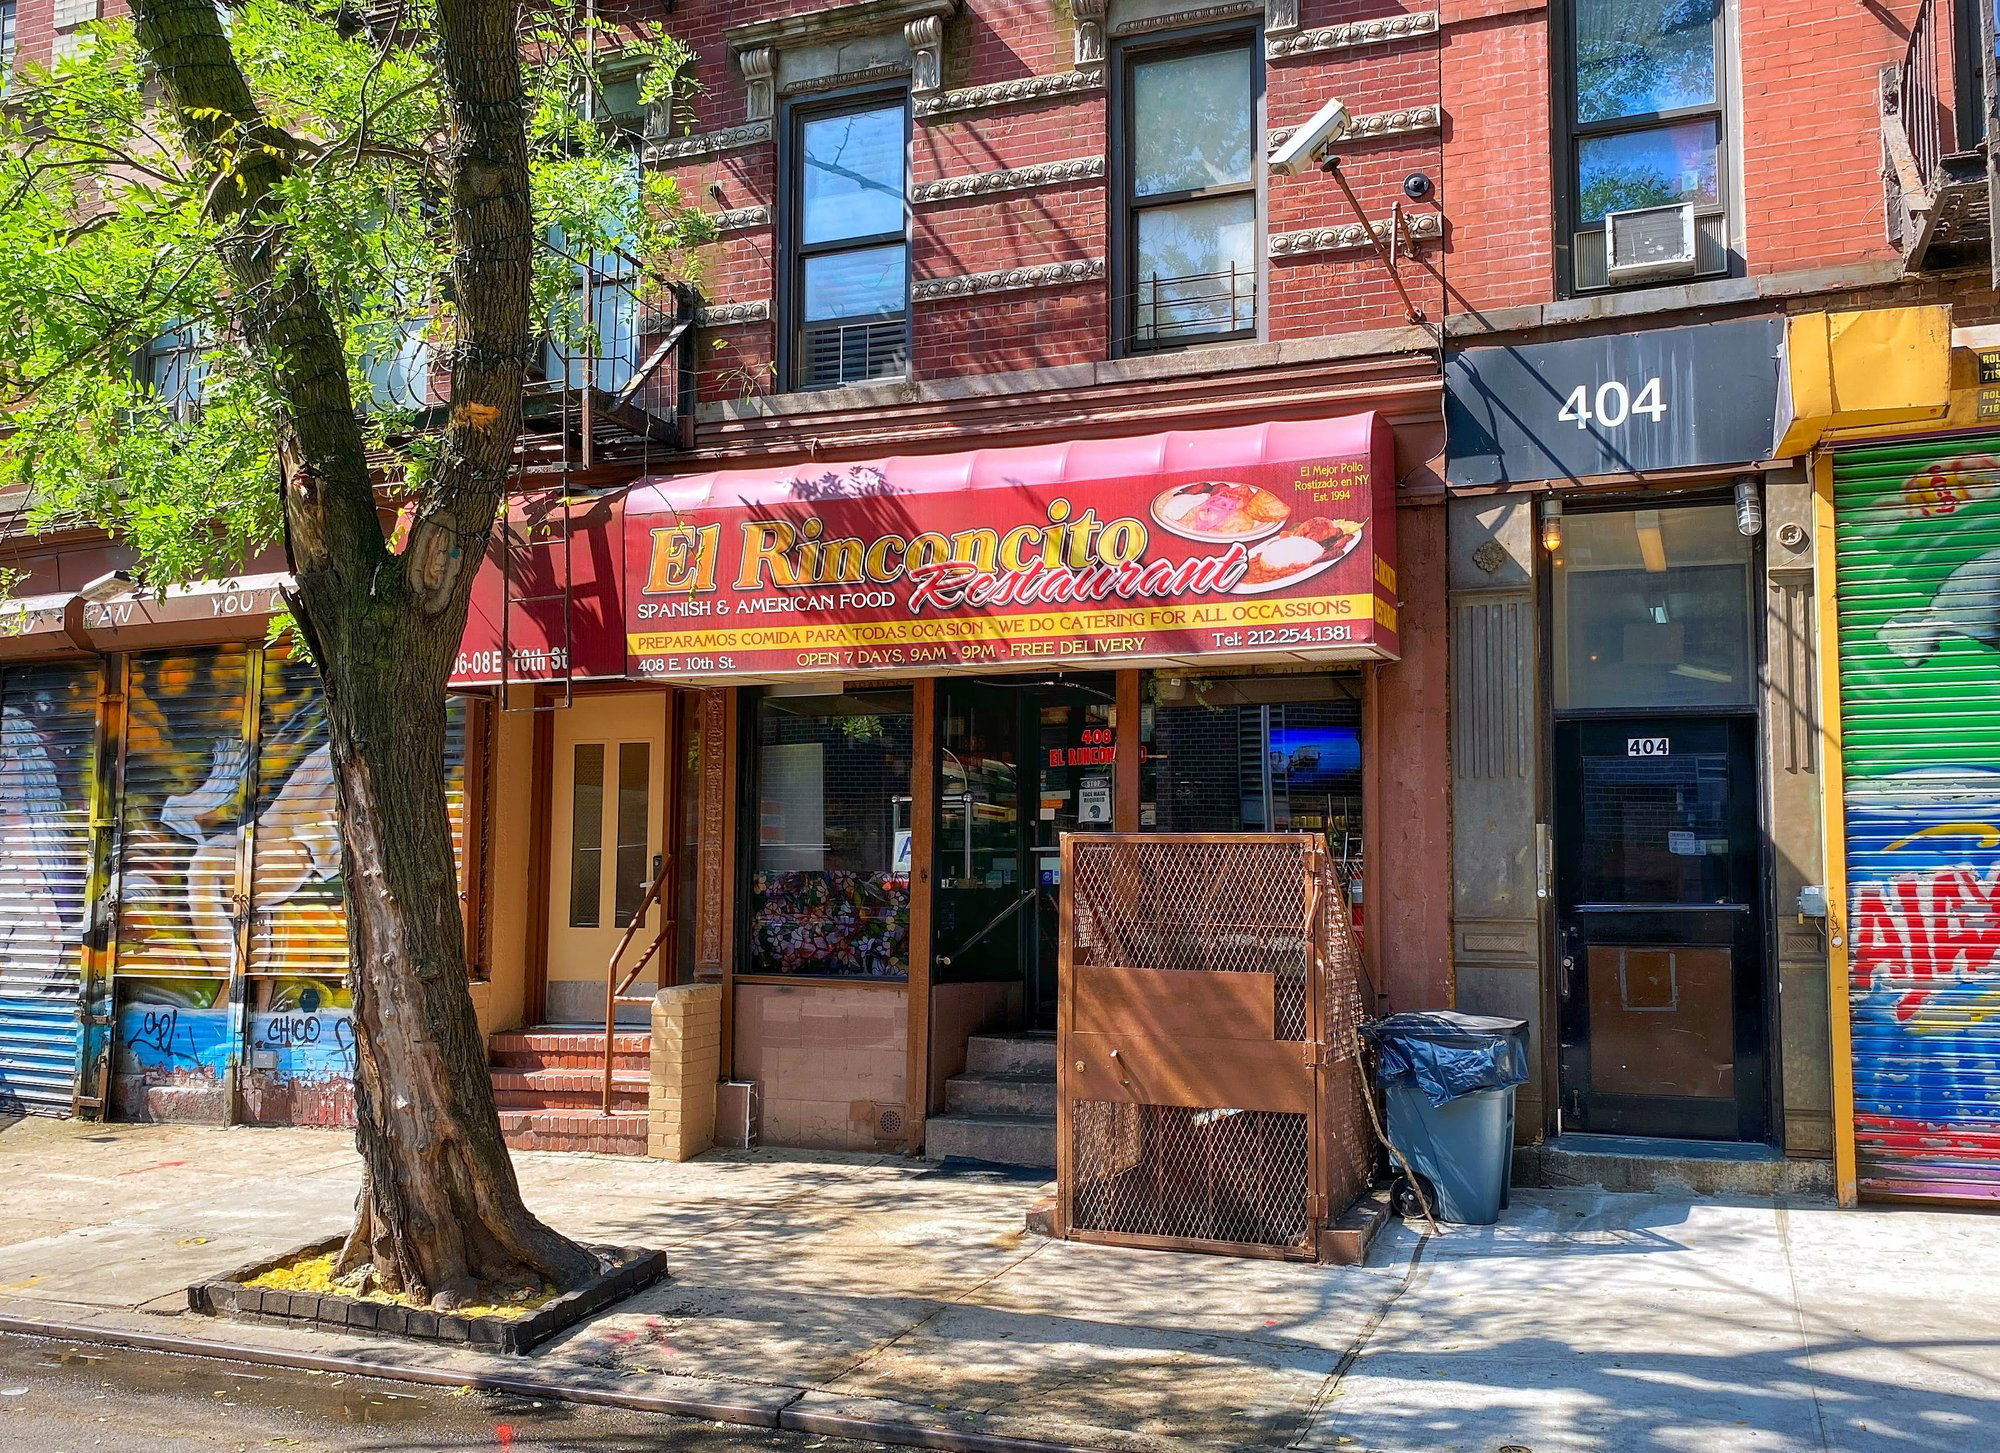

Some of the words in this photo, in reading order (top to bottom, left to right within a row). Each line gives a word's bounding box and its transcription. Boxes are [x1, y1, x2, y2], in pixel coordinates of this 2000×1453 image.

[1557, 377, 1667, 430] 404
[1300, 466, 1310, 477] El
[1312, 465, 1338, 477] Mejor
[1341, 462, 1363, 473] Pollo
[1295, 478, 1338, 491] Rostizado
[1341, 479, 1352, 487] en
[1355, 474, 1369, 486] NY
[1331, 490, 1350, 501] 1994
[642, 522, 721, 595] El
[732, 496, 1149, 591] Rinconcito
[908, 541, 1248, 614] Restaurant
[211, 592, 253, 616] YOU
[637, 600, 711, 619] SPANISH
[716, 600, 730, 615] &
[735, 595, 834, 614] AMERICAN
[840, 591, 896, 609] FOOD
[638, 633, 737, 650] PREPARAMOS
[741, 631, 800, 645] COMIDA
[806, 628, 847, 643] PARA
[853, 625, 906, 641] TODAS
[911, 621, 984, 638] OCASION
[999, 620, 1025, 633] WE
[1030, 618, 1055, 632] DO
[1060, 613, 1146, 630] CATERING
[1150, 610, 1186, 625] FOR
[1192, 608, 1227, 622] ALL
[1232, 600, 1351, 620] OCCASSIONS
[1212, 632, 1242, 647] Tel:
[1247, 625, 1352, 645] 212.254.1381
[512, 648, 546, 672] 10th
[638, 659, 664, 672] 408
[669, 658, 681, 671] E.
[685, 656, 714, 670] 10th
[718, 656, 736, 669] St.
[797, 651, 840, 667] OPEN
[844, 650, 853, 664] 7
[858, 649, 905, 664] DAYS,
[910, 646, 947, 662] 9AM
[961, 644, 996, 659] 9PM
[1010, 641, 1055, 657] FREE
[1060, 637, 1146, 654] DELIVERY
[1081, 728, 1112, 744] 408
[1629, 739, 1668, 755] 404
[1049, 748, 1066, 767] EL
[267, 1015, 321, 1044] CHICO
